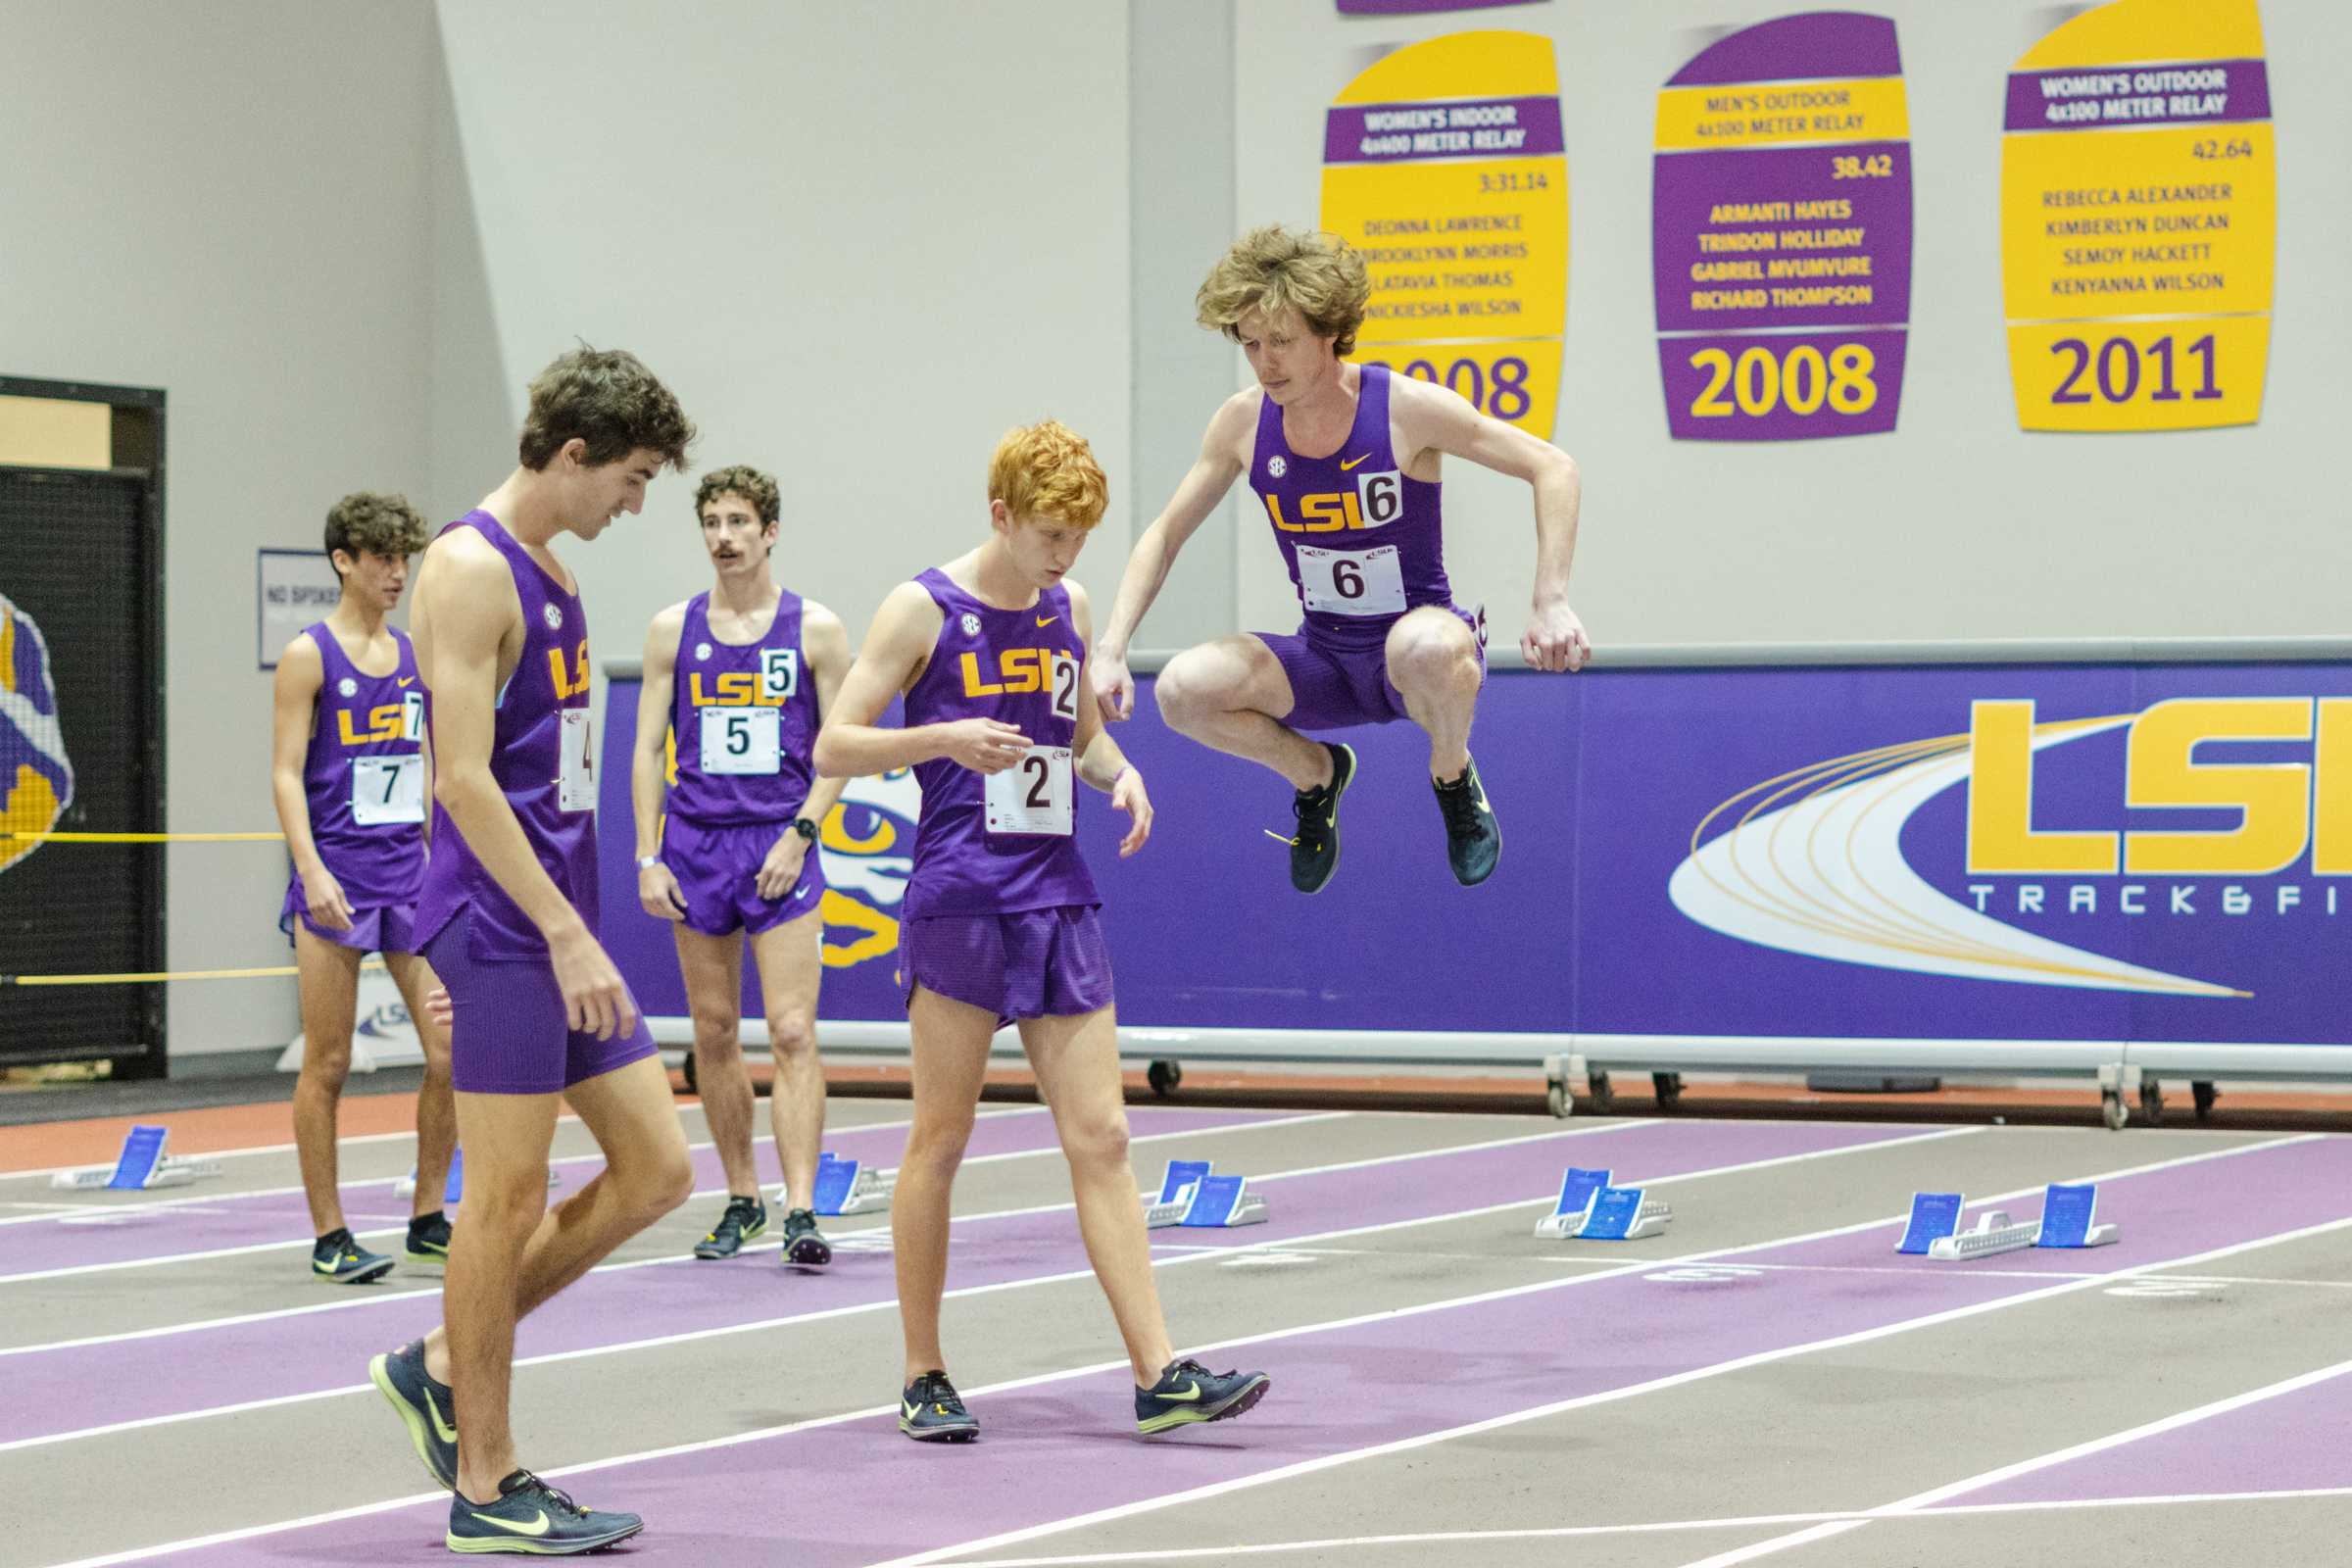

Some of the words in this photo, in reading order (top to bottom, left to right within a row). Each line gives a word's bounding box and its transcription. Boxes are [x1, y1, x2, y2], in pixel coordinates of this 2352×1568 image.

[2040, 73, 2132, 97] WOMEN'S
[2133, 69, 2228, 92] OUTDOOR
[1706, 95, 1760, 112] MEN'S
[1765, 89, 1850, 110] OUTDOOR
[2045, 100, 2100, 122] 4x100
[2102, 96, 2166, 119] METER
[2169, 93, 2228, 116] RELAY
[1364, 109, 1447, 131] WOMEN'S
[1449, 106, 1517, 126] INDOOR
[1696, 121, 1744, 138] 4x100
[1750, 117, 1807, 134] METER
[1813, 114, 1865, 130] RELAY
[1412, 131, 1471, 152] METER
[1472, 128, 1527, 149] RELAY
[2192, 138, 2253, 160] 42.64
[1832, 154, 1893, 179] 38.42
[1479, 172, 1547, 193] 3:31.14
[2042, 188, 2121, 208] REBECCA
[2126, 182, 2232, 203] ALEXANDER
[1709, 202, 1790, 223] ARMANTI
[1793, 199, 1853, 220] HAYES
[1363, 219, 1431, 236] DEONNA
[1435, 215, 1522, 232] LAWRENCE
[2045, 217, 2147, 236] KIMBERLYN
[2153, 213, 2230, 232] DUNCAN
[1463, 242, 1529, 260] MORRIS
[1698, 230, 1776, 252] TRINDON
[1780, 226, 1865, 250] HOLLIDAY
[2063, 247, 2125, 267] SEMOY
[2132, 242, 2212, 262] HACKETT
[1375, 274, 1438, 291] LATAVIA
[1442, 271, 1514, 288] THOMAS
[1690, 260, 1765, 282] GABRIEL
[1767, 256, 1872, 279] MVUMVURE
[2051, 275, 2146, 296] KENYANNA
[2152, 272, 2225, 292] WILSON
[1456, 298, 1522, 317] WILSON
[1690, 288, 1768, 311] RICHARD
[1770, 285, 1873, 307] THOMPSON
[1690, 343, 1879, 418] 2008
[2049, 333, 2225, 406] 2011
[1364, 356, 1531, 419] 08
[1366, 476, 1396, 522] 6
[1332, 559, 1365, 600] 6
[767, 654, 791, 693] 5
[1055, 661, 1074, 715] 2
[336, 704, 406, 746] LS
[411, 697, 422, 736] 7
[725, 716, 751, 756] 5
[381, 764, 401, 804] 7
[1023, 755, 1052, 808] 2
